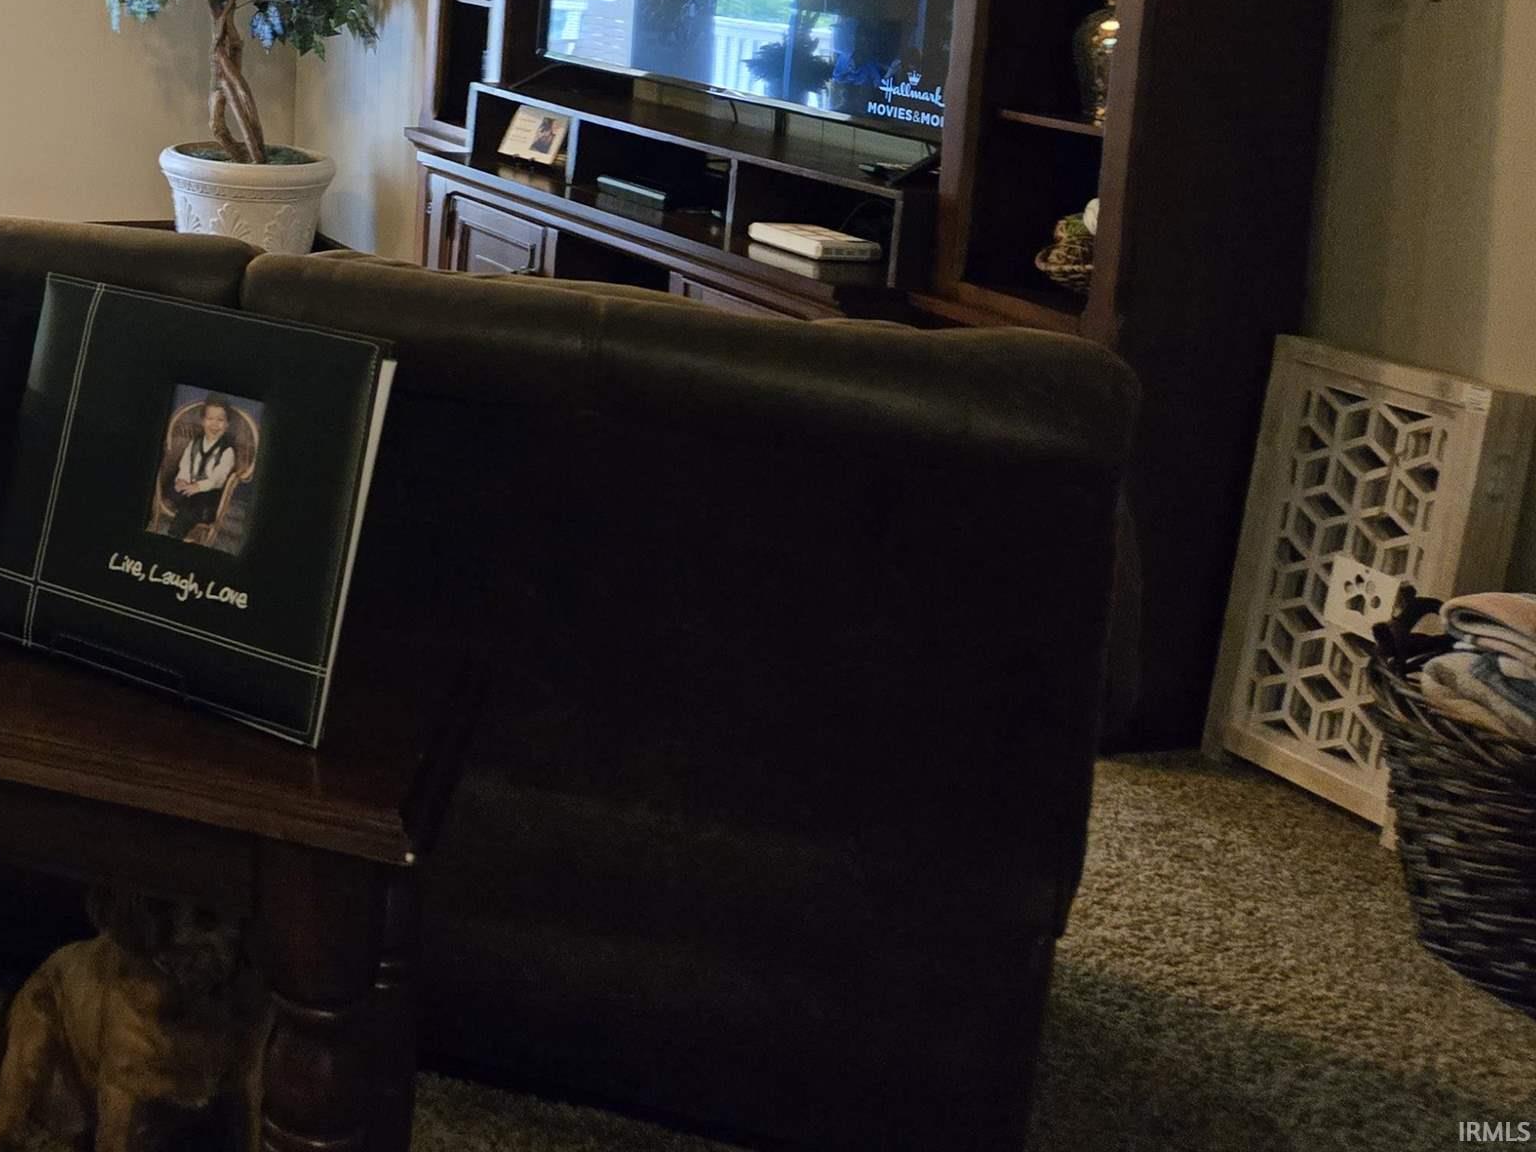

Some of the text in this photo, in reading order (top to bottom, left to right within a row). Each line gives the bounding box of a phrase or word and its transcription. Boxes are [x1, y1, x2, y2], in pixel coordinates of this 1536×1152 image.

[879, 77, 945, 107] Hallmark
[867, 101, 944, 128] MOVIES&MO
[108, 552, 248, 609] Live, Laugh, Love
